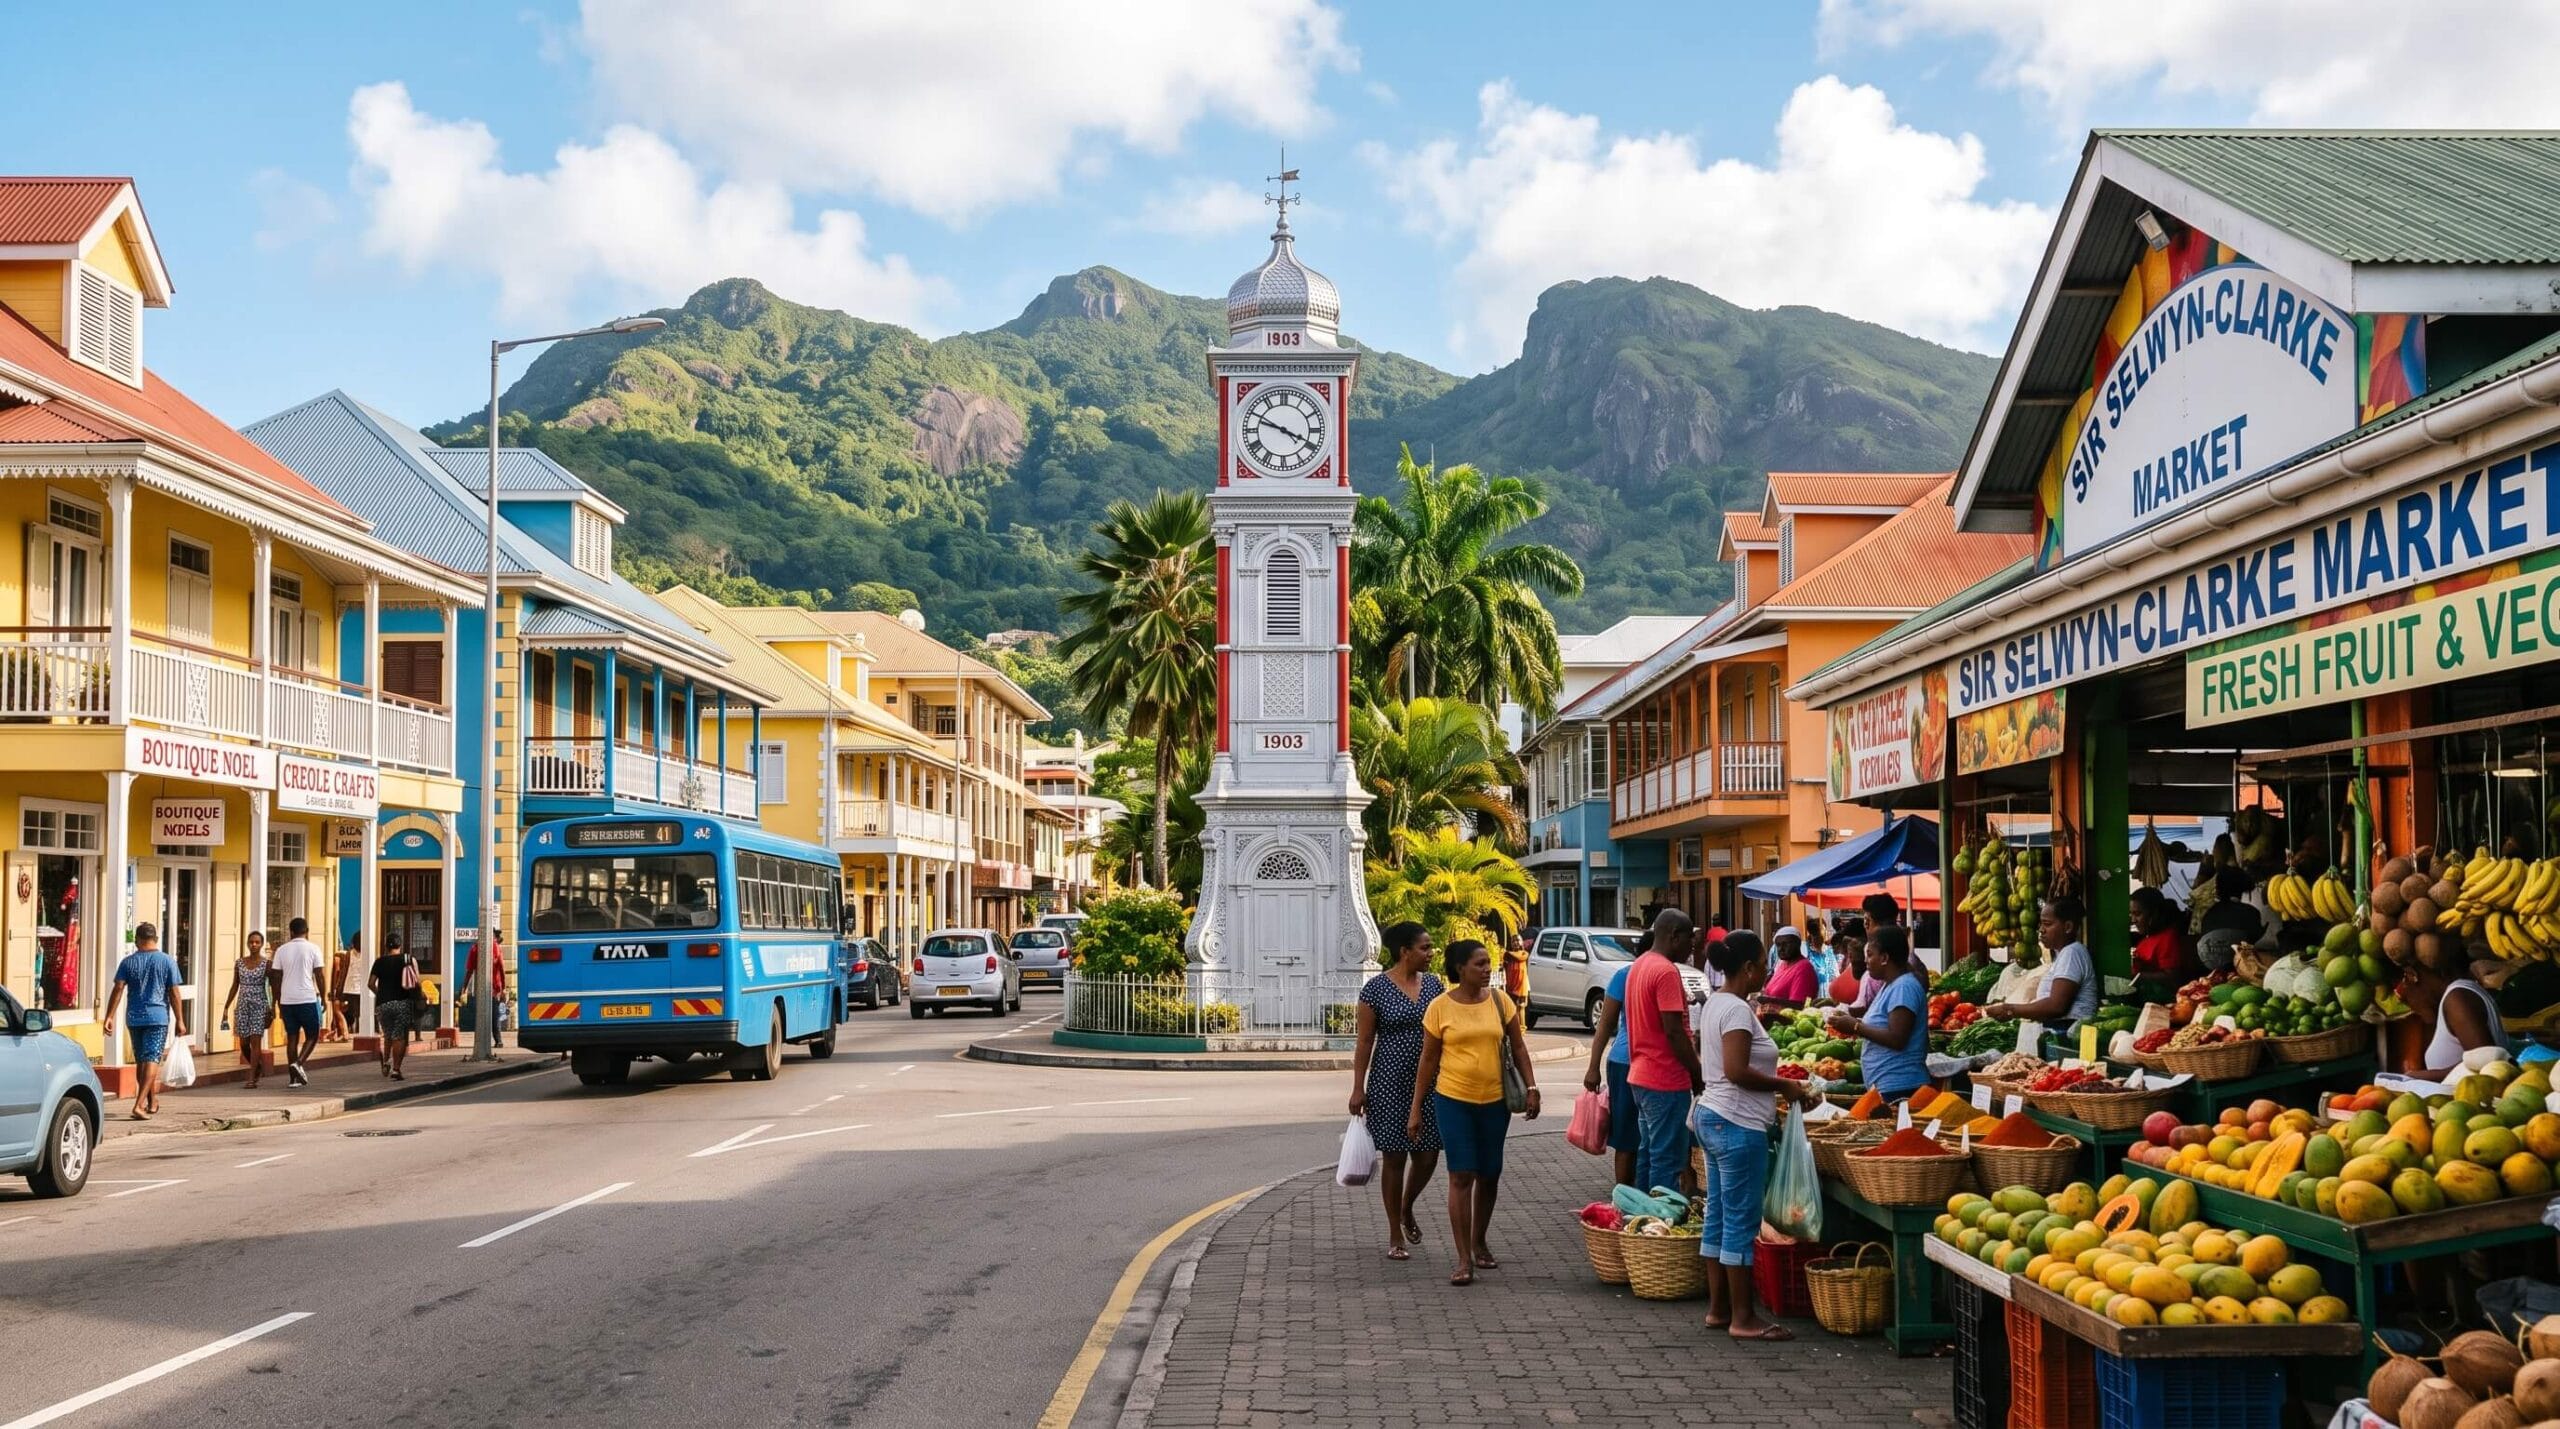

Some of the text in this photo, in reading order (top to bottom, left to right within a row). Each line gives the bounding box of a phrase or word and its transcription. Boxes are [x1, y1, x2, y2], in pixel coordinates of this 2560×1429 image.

[1267, 332, 1300, 346] 1903
[2072, 279, 2340, 504] SIR SELWYN-CLARKE
[2133, 414, 2248, 518] MARKET
[1959, 441, 2560, 707] SIR SELWYN-CLARKE MARKET
[2202, 643, 2301, 717] FRESH
[2314, 613, 2421, 694] FRUIT
[2436, 604, 2465, 670] &
[142, 738, 258, 780] BOUTIQUE NOEL
[1263, 735, 1303, 749] 1903
[283, 763, 375, 800] CREOLE CRAFTS
[155, 806, 220, 821] BOUTIQUE
[656, 826, 670, 841] 41
[600, 944, 649, 959] TATA
